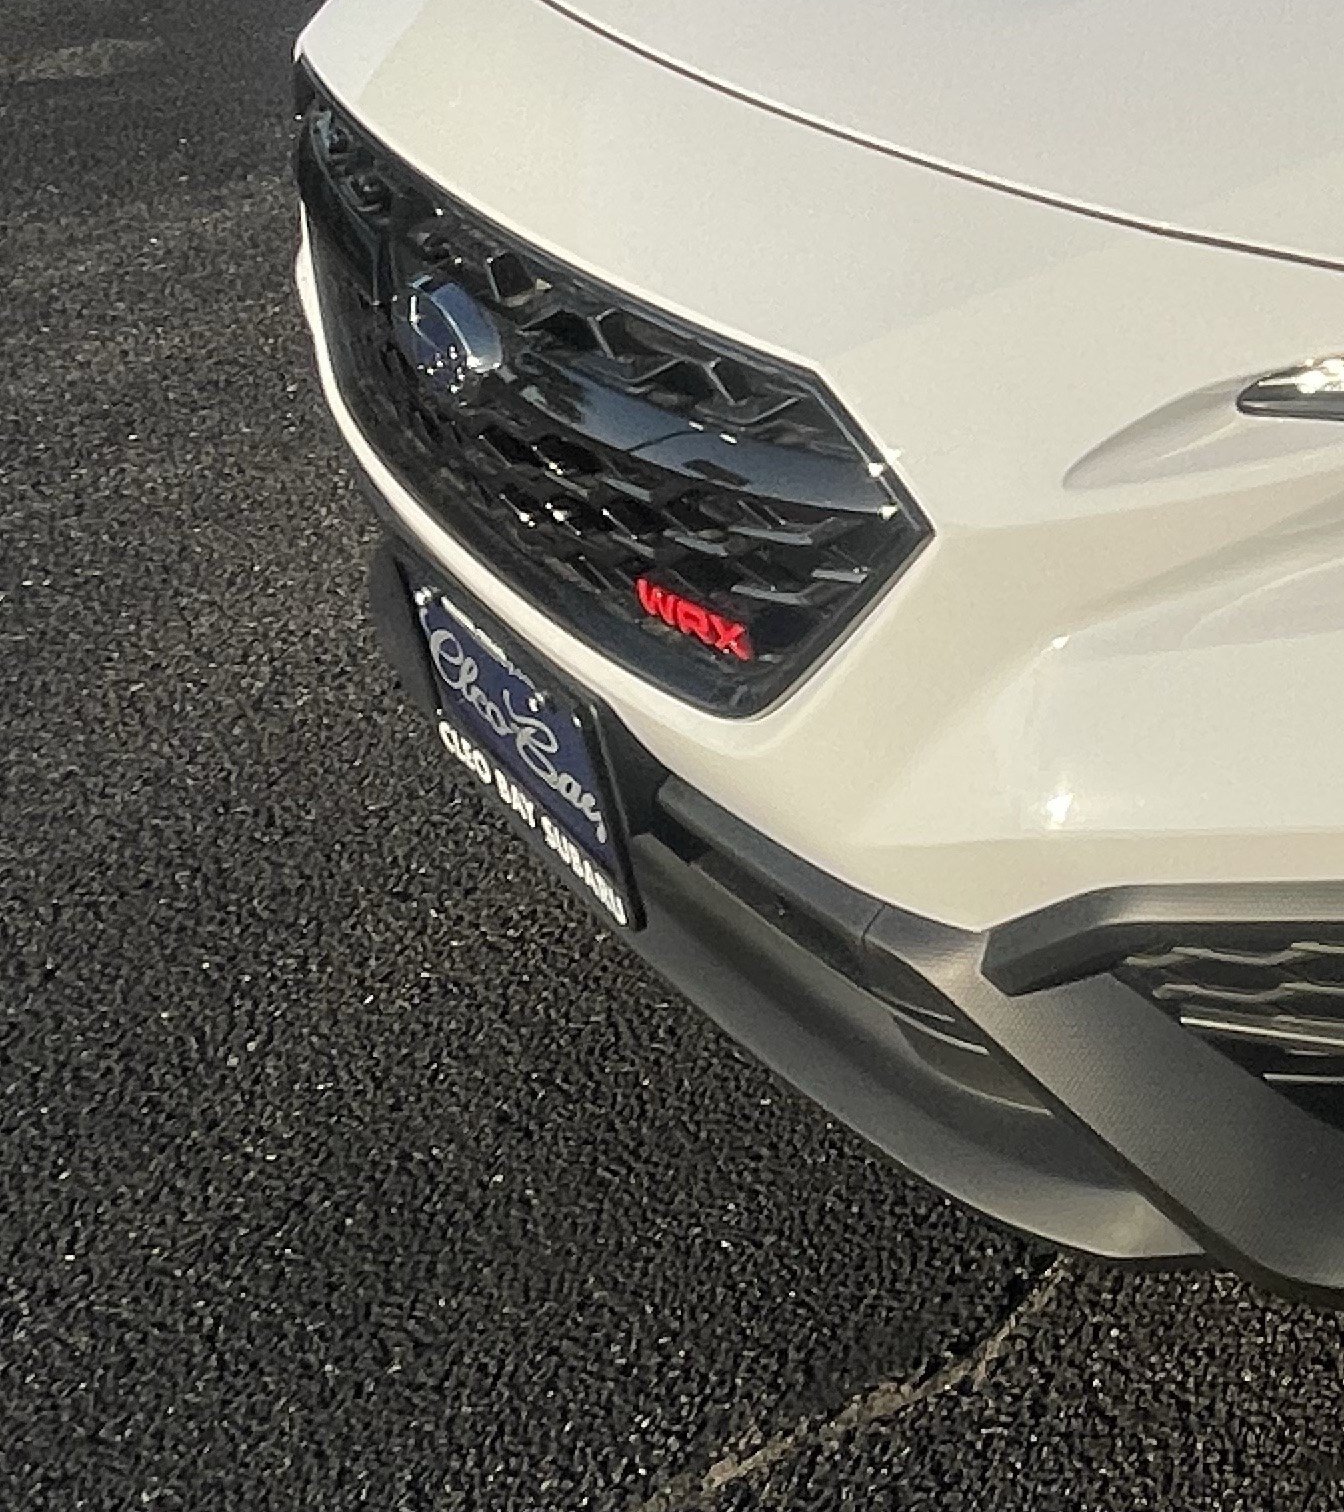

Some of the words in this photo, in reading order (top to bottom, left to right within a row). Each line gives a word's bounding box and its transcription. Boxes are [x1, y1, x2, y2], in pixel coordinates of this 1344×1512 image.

[636, 577, 752, 661] WRX
[438, 720, 492, 784] CLEO
[494, 769, 536, 828] BAY
